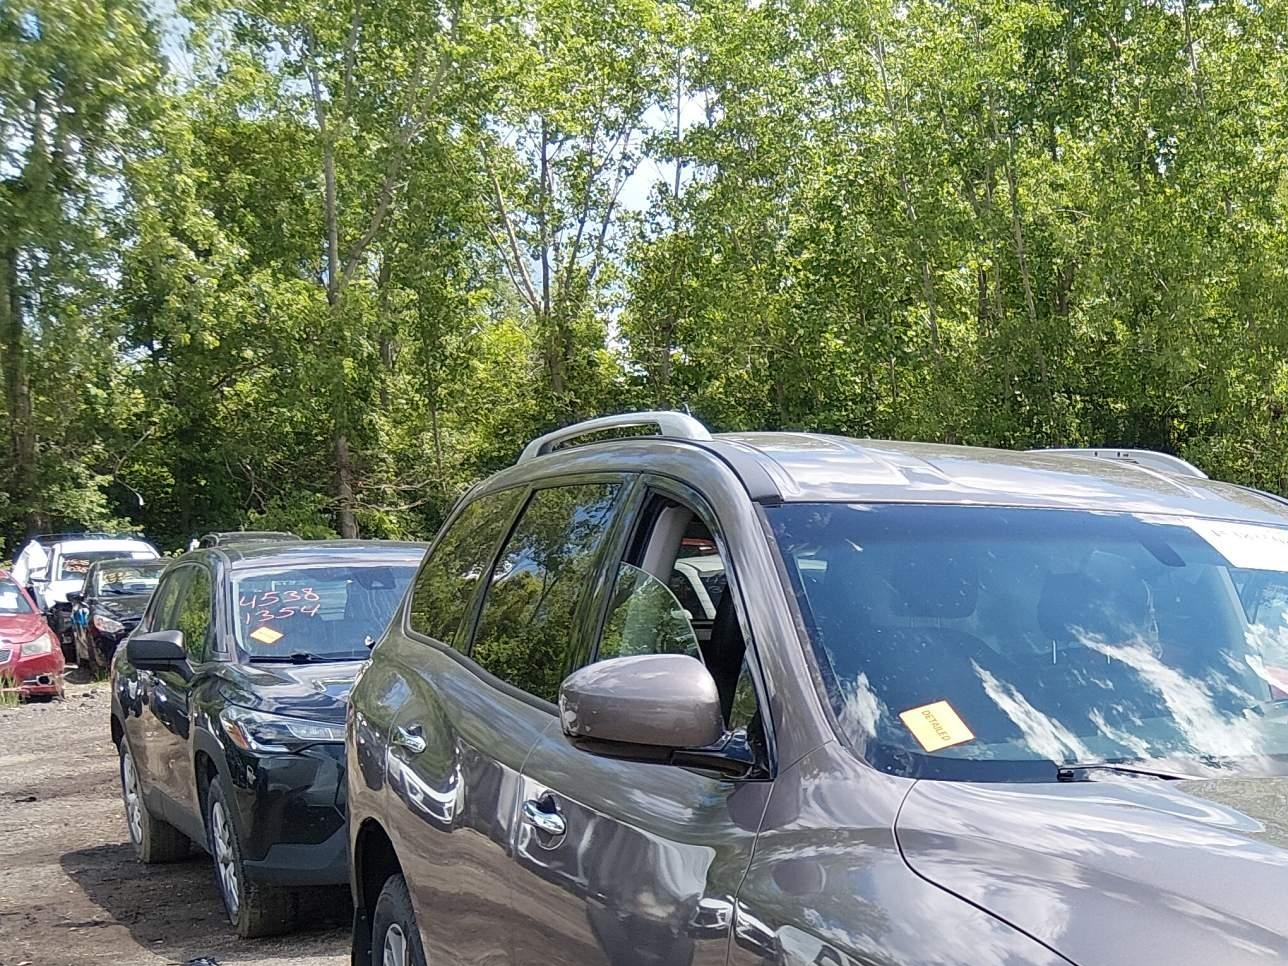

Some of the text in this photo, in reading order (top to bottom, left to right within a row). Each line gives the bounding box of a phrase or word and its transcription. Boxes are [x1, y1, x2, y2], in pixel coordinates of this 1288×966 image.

[239, 587, 320, 608] 4538
[245, 604, 321, 624] 1354
[921, 710, 951, 741] DETAILED
